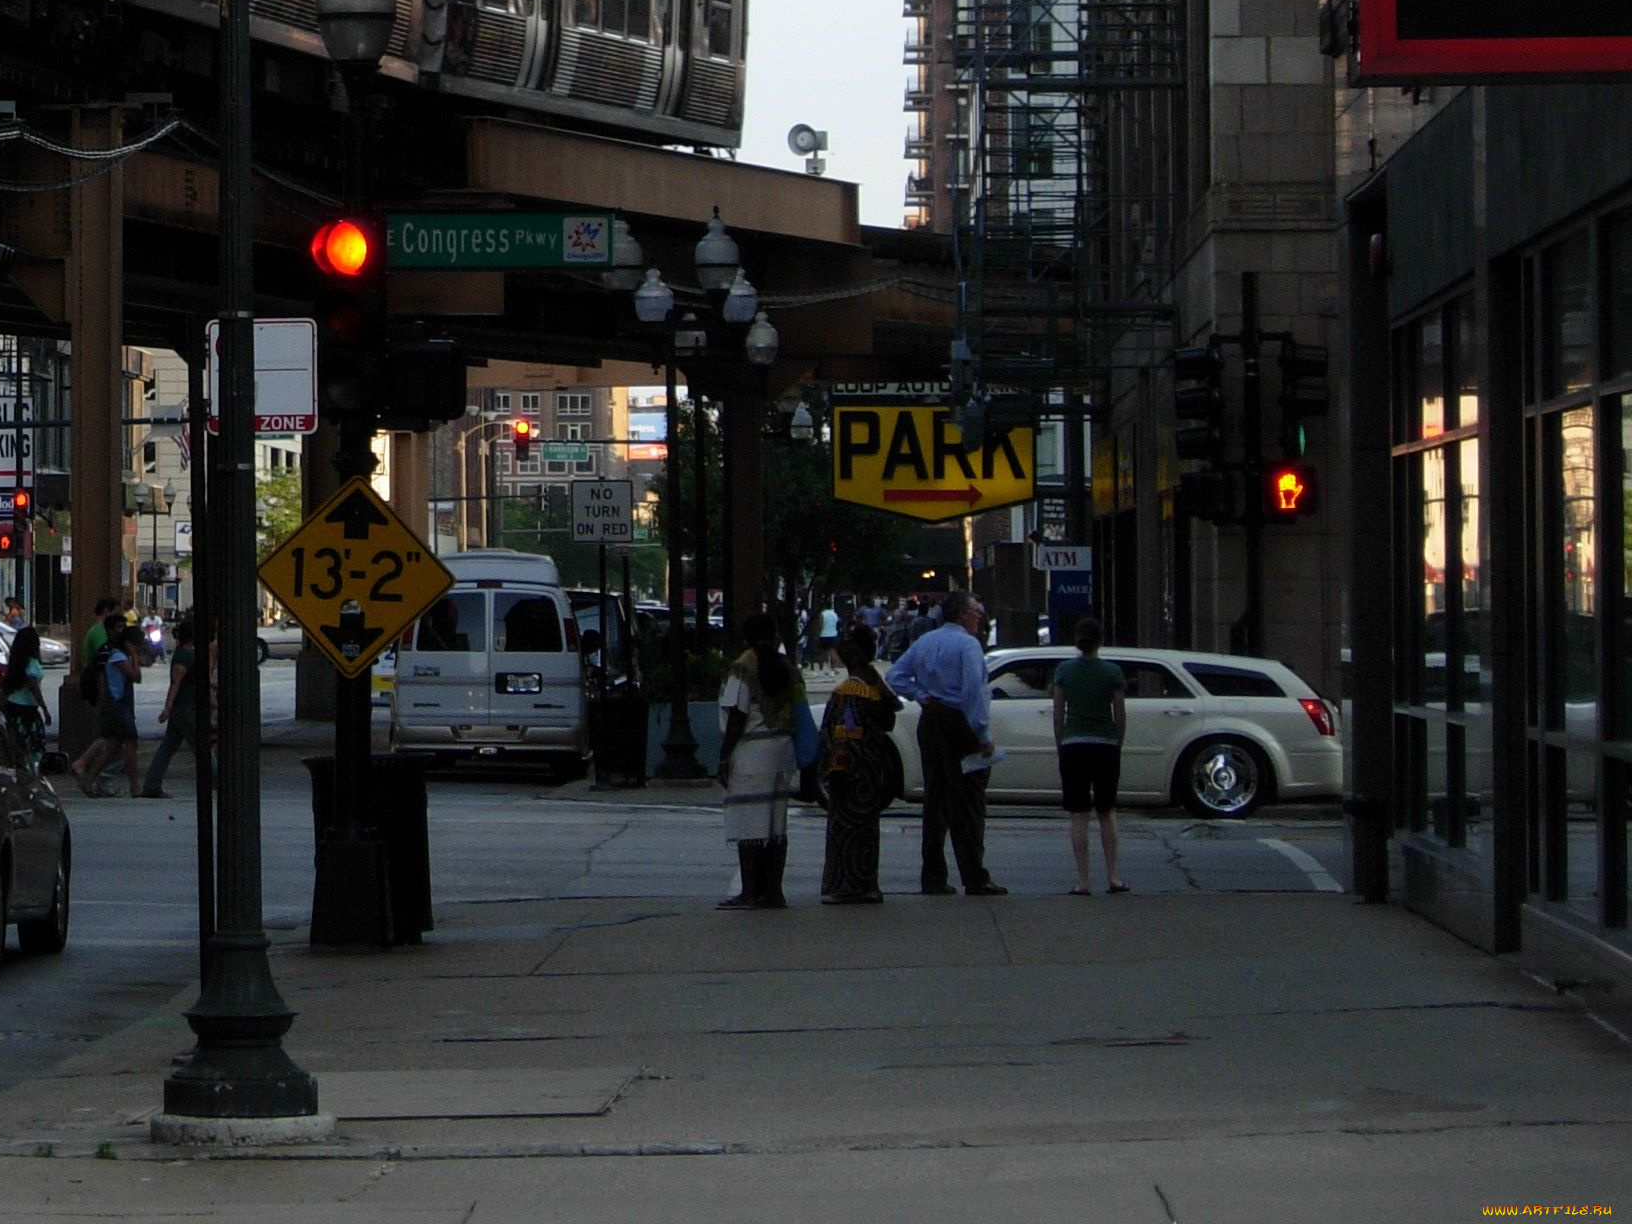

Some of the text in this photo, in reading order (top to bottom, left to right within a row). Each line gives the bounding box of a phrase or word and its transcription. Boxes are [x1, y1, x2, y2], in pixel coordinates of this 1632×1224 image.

[386, 222, 558, 263] E Congress Pkwy
[260, 416, 306, 431] ZONE
[839, 410, 1026, 480] PARK
[590, 488, 613, 500] NO
[584, 505, 620, 518] TURN
[576, 523, 594, 535] ON
[603, 523, 628, 535] RED
[1043, 551, 1078, 566] ATM
[291, 547, 421, 602] 13'-2"
